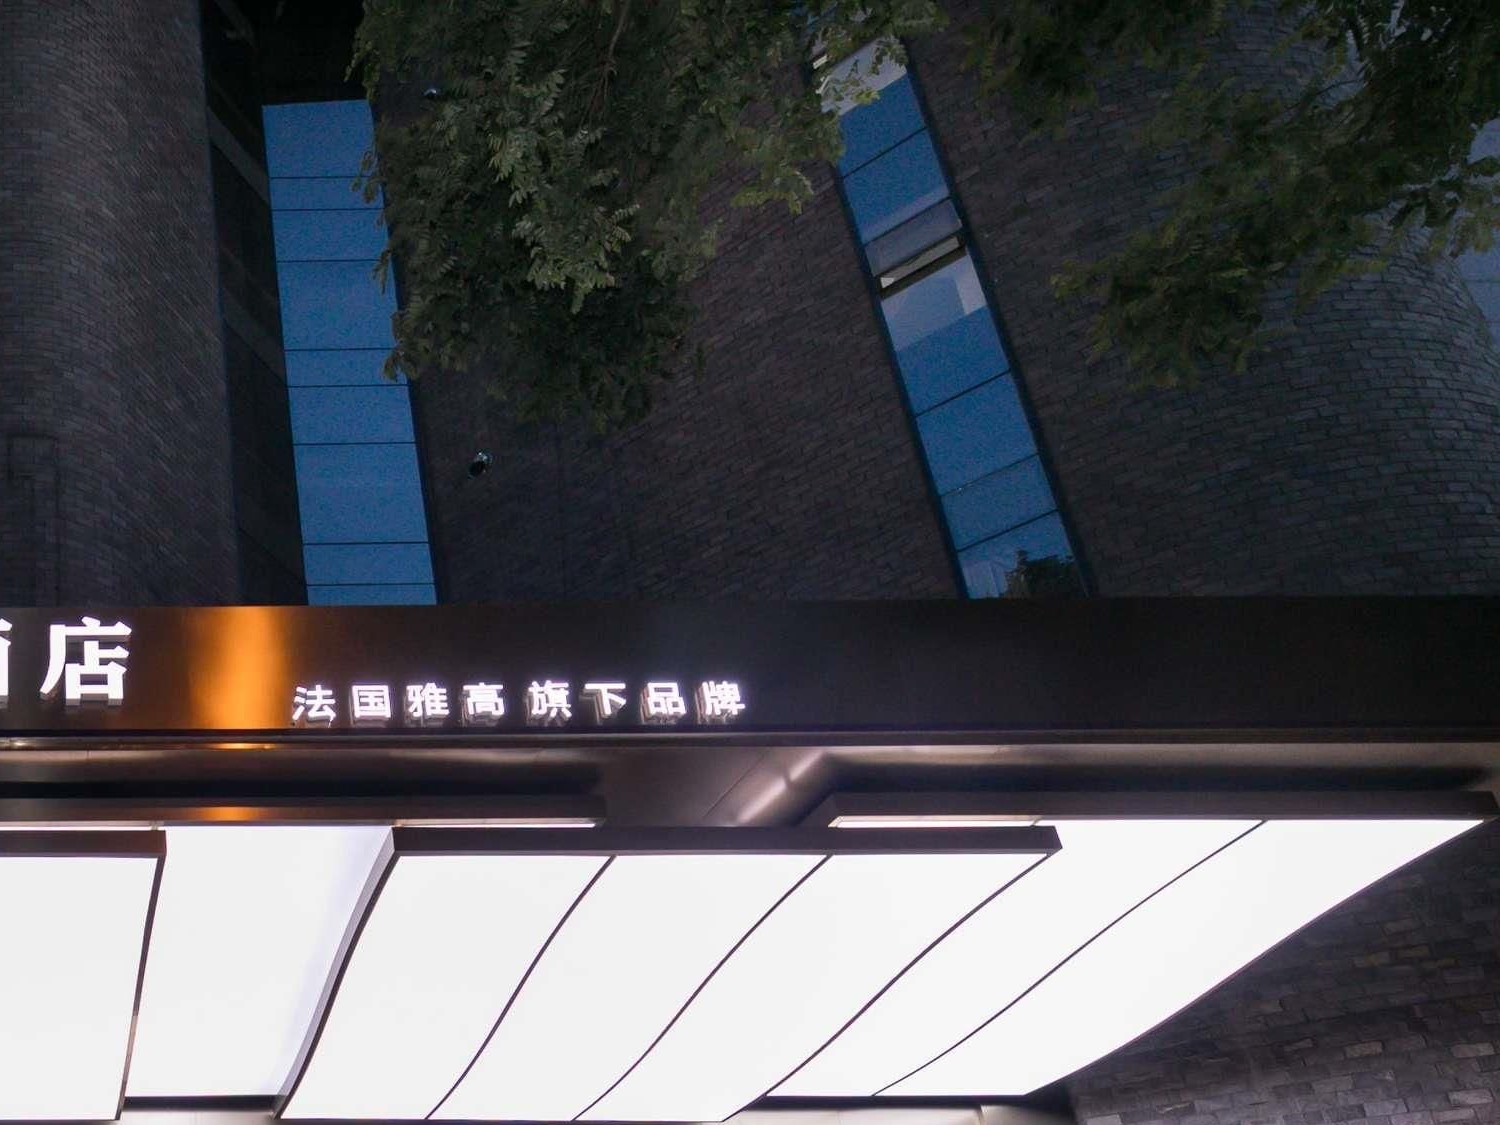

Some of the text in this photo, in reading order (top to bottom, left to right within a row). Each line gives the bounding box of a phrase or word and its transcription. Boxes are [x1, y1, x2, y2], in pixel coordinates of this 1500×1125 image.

[291, 679, 748, 723] 法国雅高旗下品牌
